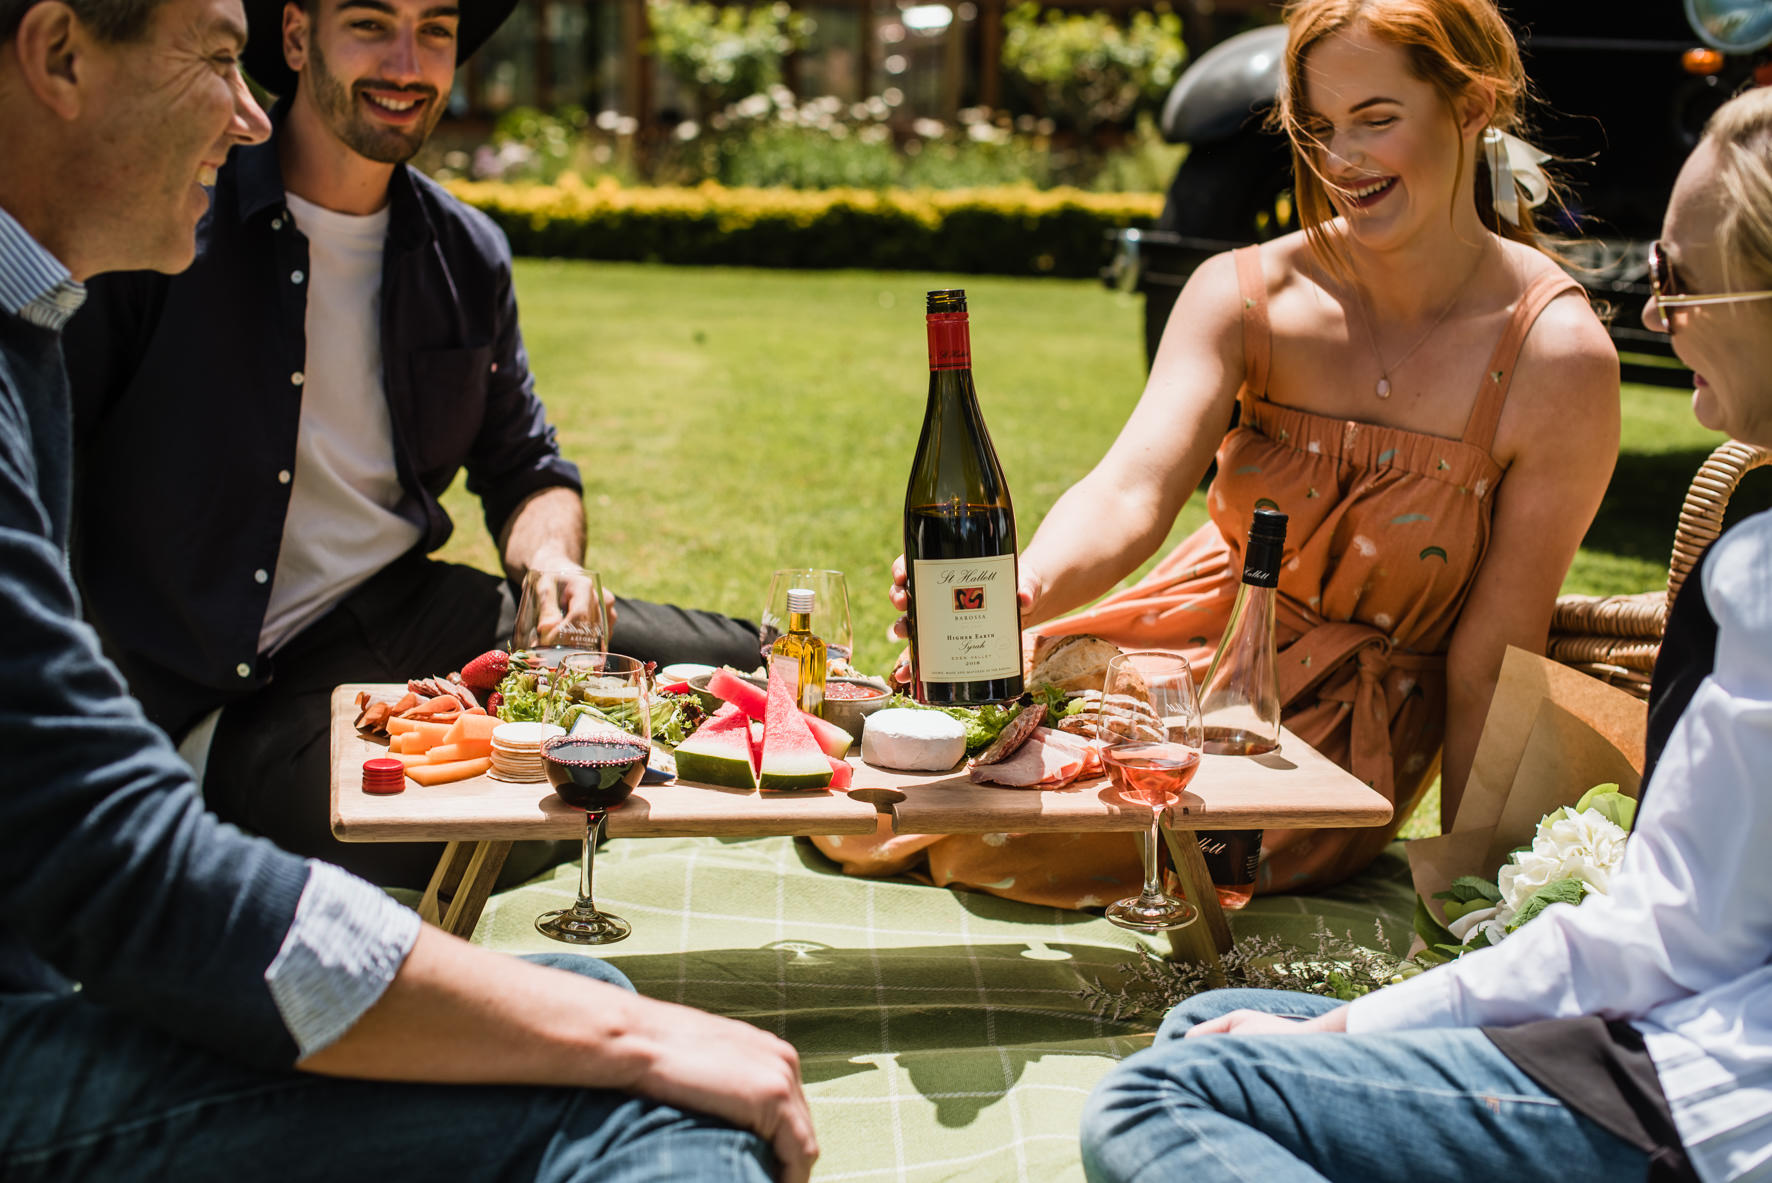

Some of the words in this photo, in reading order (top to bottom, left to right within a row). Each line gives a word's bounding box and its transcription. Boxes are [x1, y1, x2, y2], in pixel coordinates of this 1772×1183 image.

[937, 569, 954, 585] St
[959, 568, 998, 585] Hallett
[958, 640, 986, 654] Syrah
[1198, 837, 1227, 855] llett
